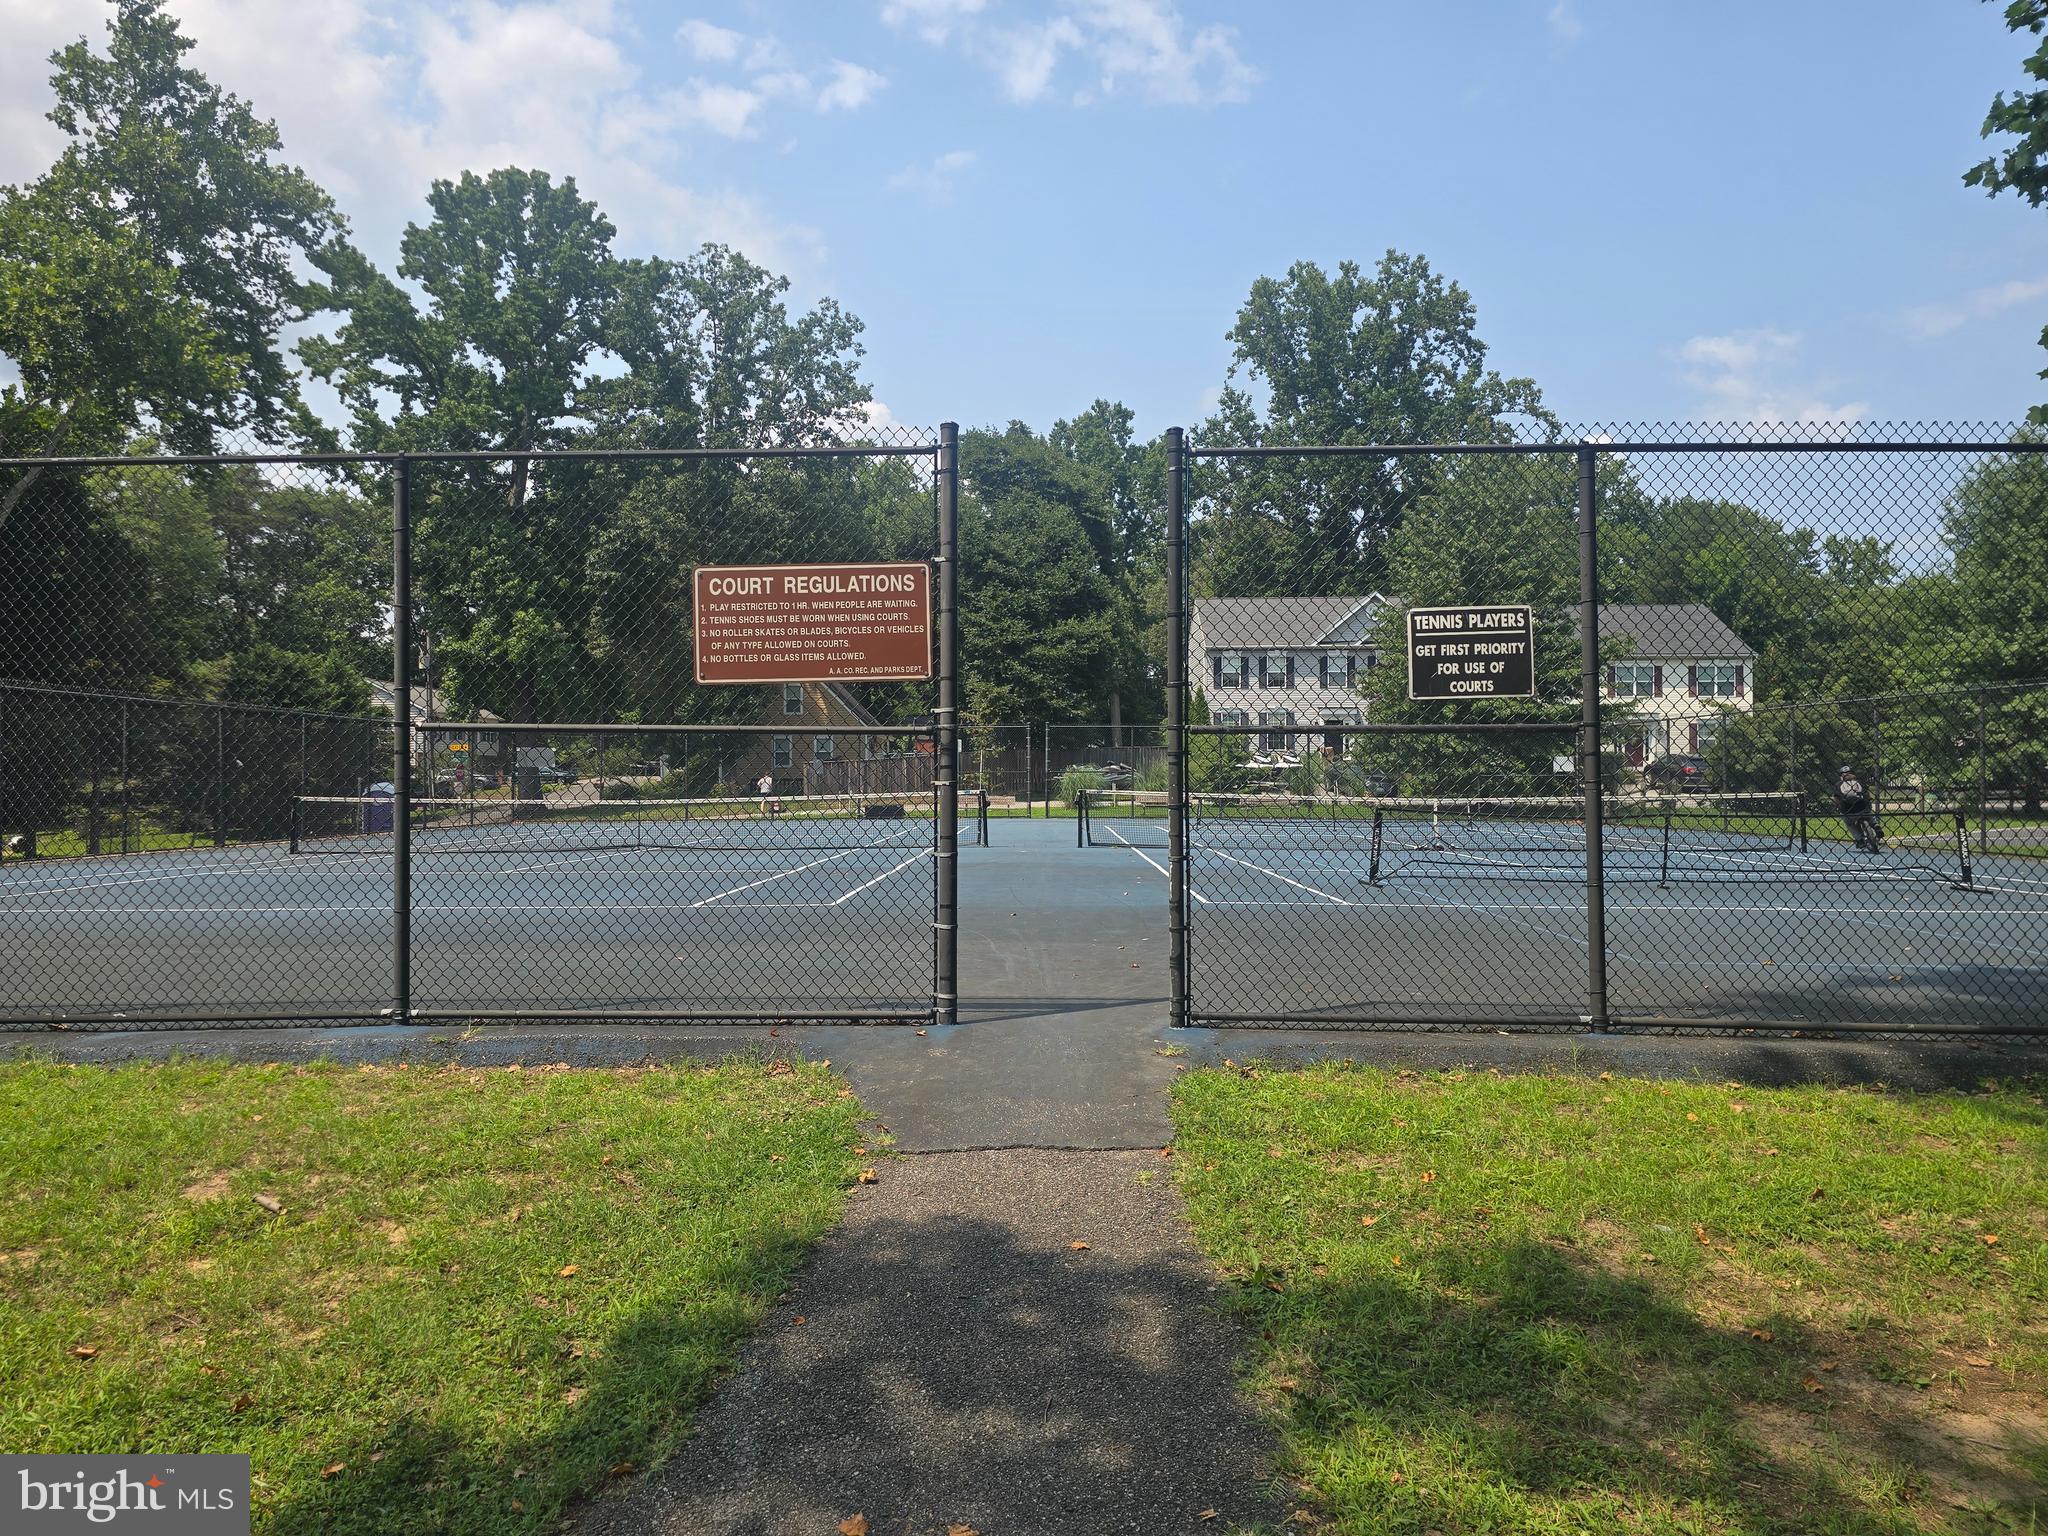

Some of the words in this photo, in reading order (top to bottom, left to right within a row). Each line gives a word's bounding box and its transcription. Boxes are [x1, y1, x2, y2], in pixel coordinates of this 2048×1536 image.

[709, 577, 774, 596] COURT
[784, 574, 915, 594] REGULATIONS
[731, 602, 778, 610] RESTRICTED
[836, 601, 865, 609] PEOPLE
[739, 616, 764, 624] SHOES
[766, 615, 788, 623] MUST
[802, 614, 825, 622] WORN
[827, 614, 850, 622] WHEN
[852, 613, 875, 621] USING
[1414, 614, 1463, 630] TENNIS
[1469, 613, 1525, 628] PLAYERS
[723, 628, 753, 636] ROLLER
[755, 628, 785, 636] SKATES
[800, 627, 833, 636] BLADES,
[835, 626, 872, 634] BICYCLES
[874, 626, 885, 634] OR
[887, 625, 924, 633] VEHICLES
[764, 641, 802, 649] ALLOWED
[1415, 645, 1436, 657] GET
[1441, 643, 1470, 656] FIRST
[1474, 642, 1525, 655] PRIORITY
[801, 653, 825, 661] ITEMS
[827, 652, 866, 660] ALLOWED.
[1437, 663, 1460, 675] FOR
[1464, 662, 1485, 674] USE
[1490, 662, 1505, 673] OF
[1450, 680, 1494, 692] COURTS
